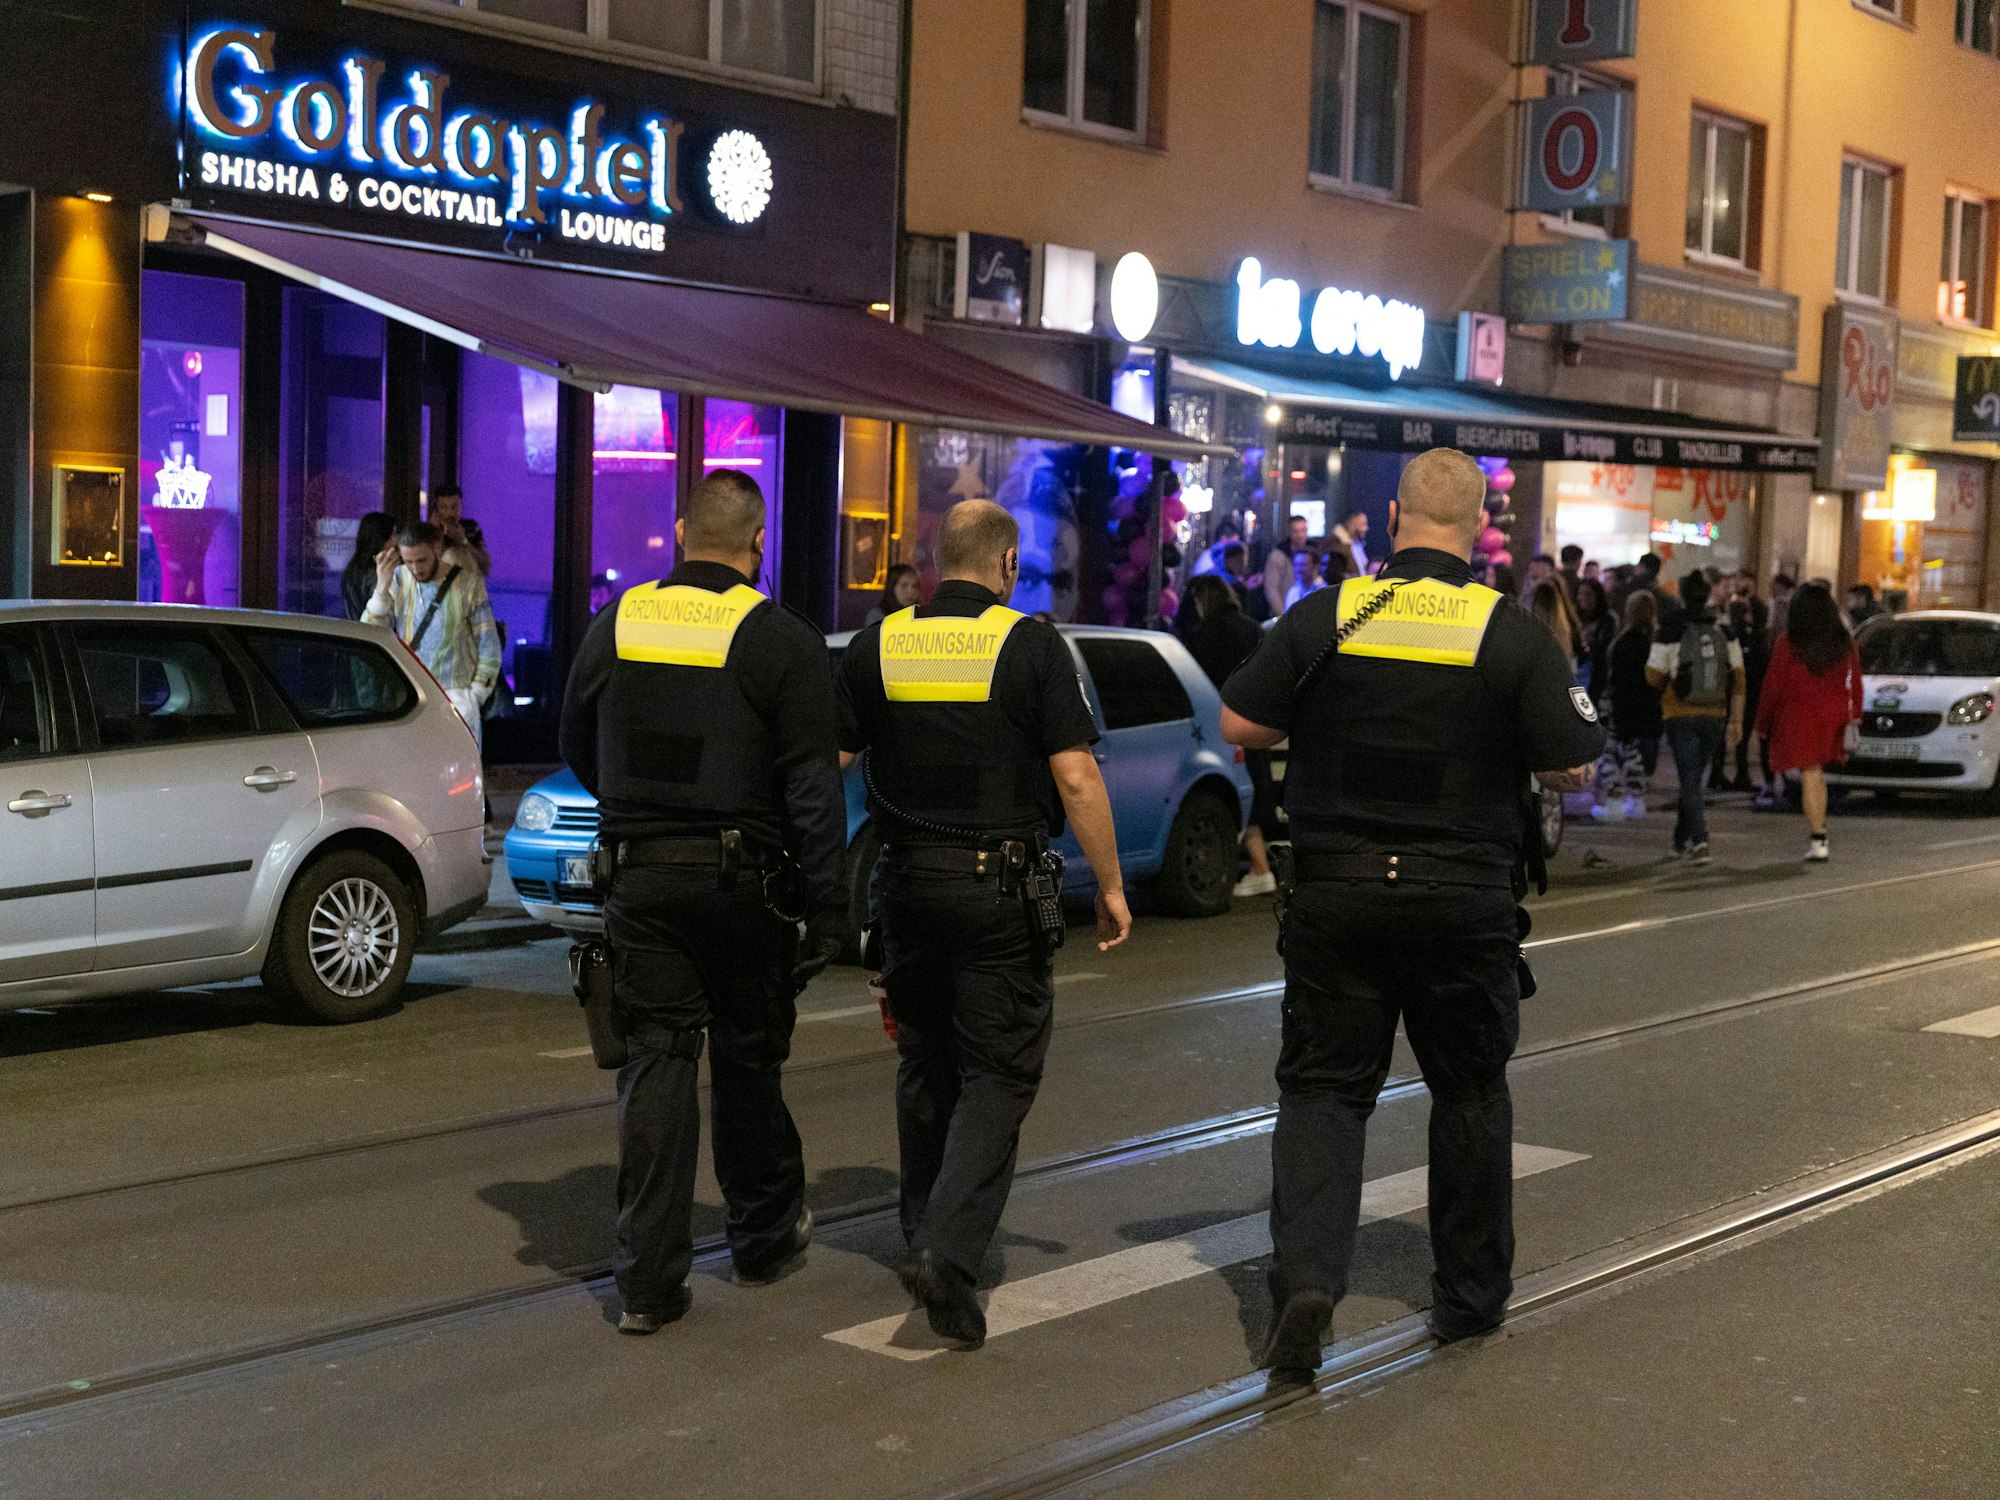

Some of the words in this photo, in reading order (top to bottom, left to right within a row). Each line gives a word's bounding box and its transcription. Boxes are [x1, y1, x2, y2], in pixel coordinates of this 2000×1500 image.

[188, 30, 684, 224] Goldapfel
[202, 152, 319, 199] SHISHA
[330, 172, 349, 203] &
[358, 177, 502, 227] COCKTAIL
[561, 208, 665, 251] LOUNGE
[1512, 249, 1596, 279] SPIEL
[1512, 285, 1612, 316] SALON
[1402, 420, 1433, 445] BAR
[1455, 425, 1540, 450] BIERGARTEN
[1633, 437, 1663, 459] CLUB
[625, 600, 736, 625] ORDNUNGSAMT
[886, 631, 998, 655] ORDNUNGSAMT
